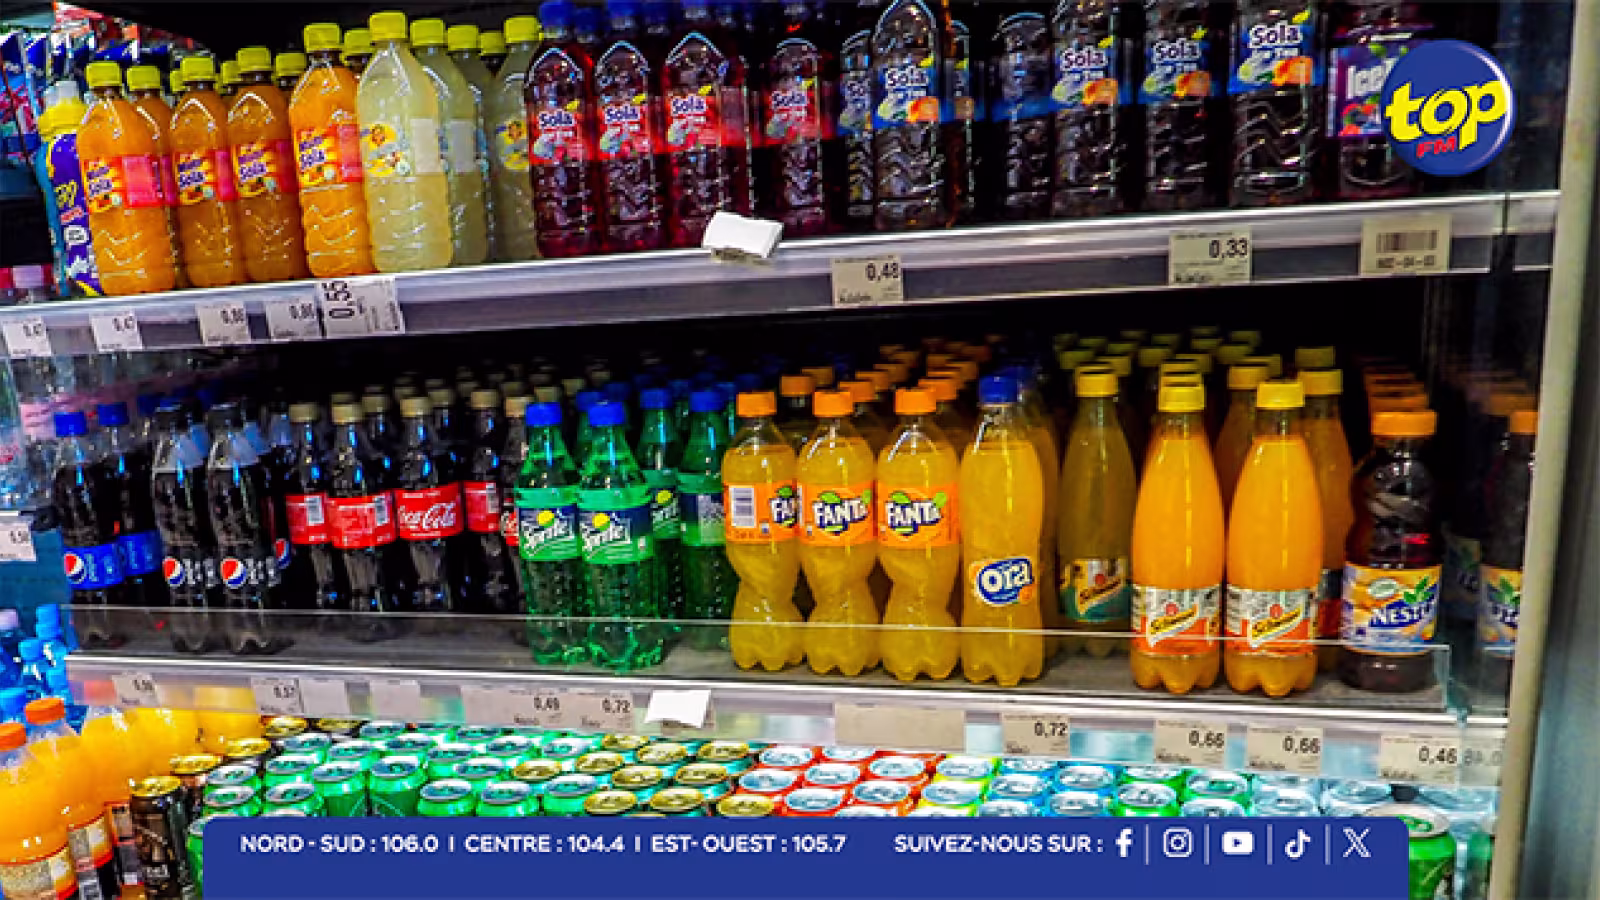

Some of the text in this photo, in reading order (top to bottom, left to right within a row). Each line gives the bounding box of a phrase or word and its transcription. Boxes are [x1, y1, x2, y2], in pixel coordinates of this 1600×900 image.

[1250, 22, 1300, 46] Sola
[1063, 46, 1104, 68] Sola
[1155, 40, 1199, 61] Sola
[886, 66, 928, 88] Sola
[672, 95, 706, 115] Sola
[773, 91, 808, 109] Sola
[539, 110, 575, 128] Sola
[605, 105, 640, 124] Sola
[1209, 239, 1248, 260] 0,33
[813, 498, 868, 526] FANTA
[885, 500, 942, 526] FANTA
[520, 517, 571, 551] Sprite
[579, 519, 627, 553] Sprite
[1034, 721, 1068, 738] 0,72
[1419, 745, 1458, 765] 0,46
